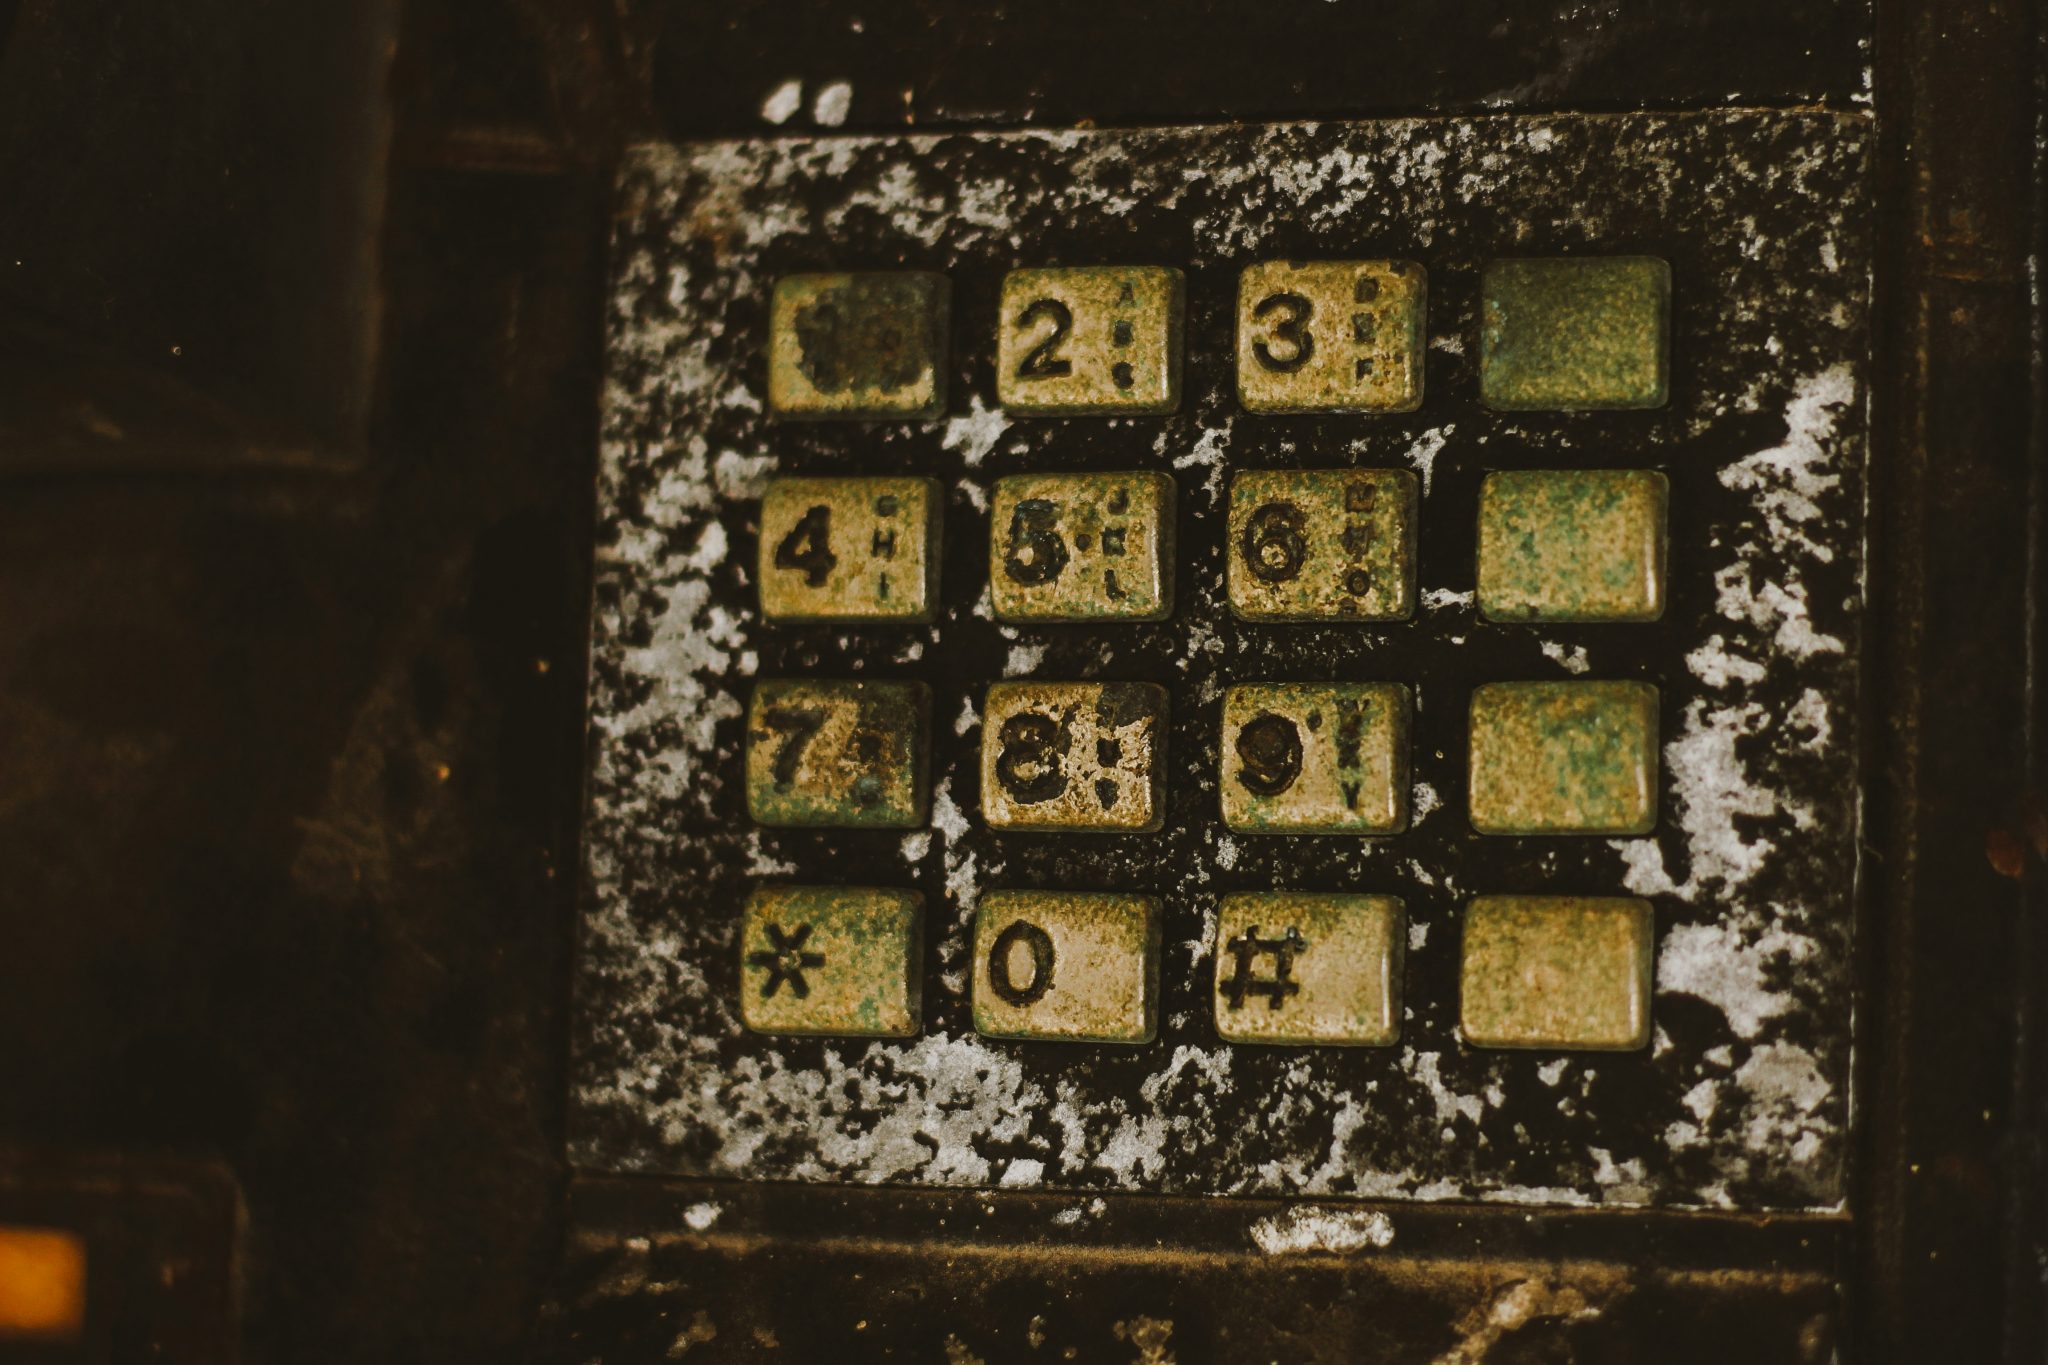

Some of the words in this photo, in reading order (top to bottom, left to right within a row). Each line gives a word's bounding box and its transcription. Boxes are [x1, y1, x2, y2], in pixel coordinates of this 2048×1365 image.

[1016, 298, 1072, 378] 2
[1252, 292, 1313, 373] 3
[775, 504, 837, 587] 4
[1004, 497, 1070, 587] 5
[1243, 502, 1306, 584] 6
[763, 708, 826, 794] 7
[997, 712, 1068, 805] 8
[1236, 708, 1303, 797] 9
